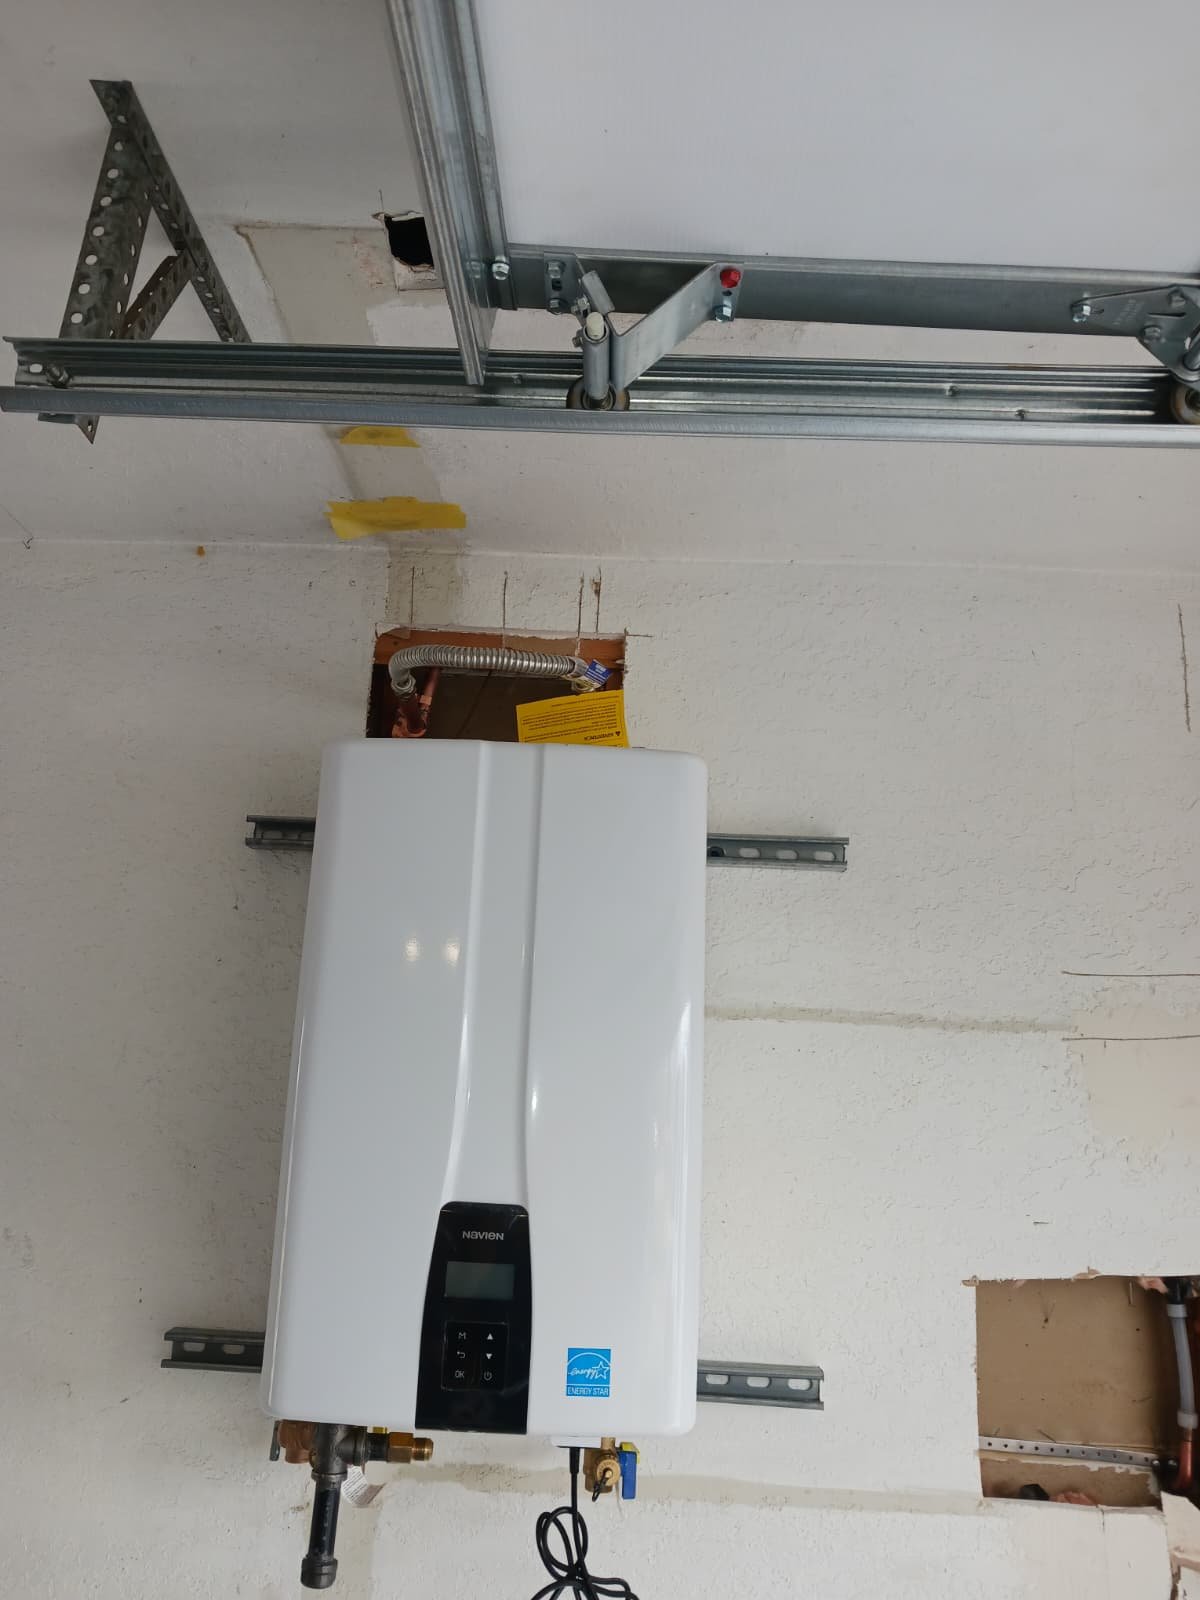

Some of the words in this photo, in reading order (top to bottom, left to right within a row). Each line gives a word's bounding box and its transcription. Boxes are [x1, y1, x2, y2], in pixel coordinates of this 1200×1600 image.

[455, 1370, 465, 1379] OK
[567, 1386, 592, 1395] ENERGY
[592, 1387, 609, 1396] STAR
